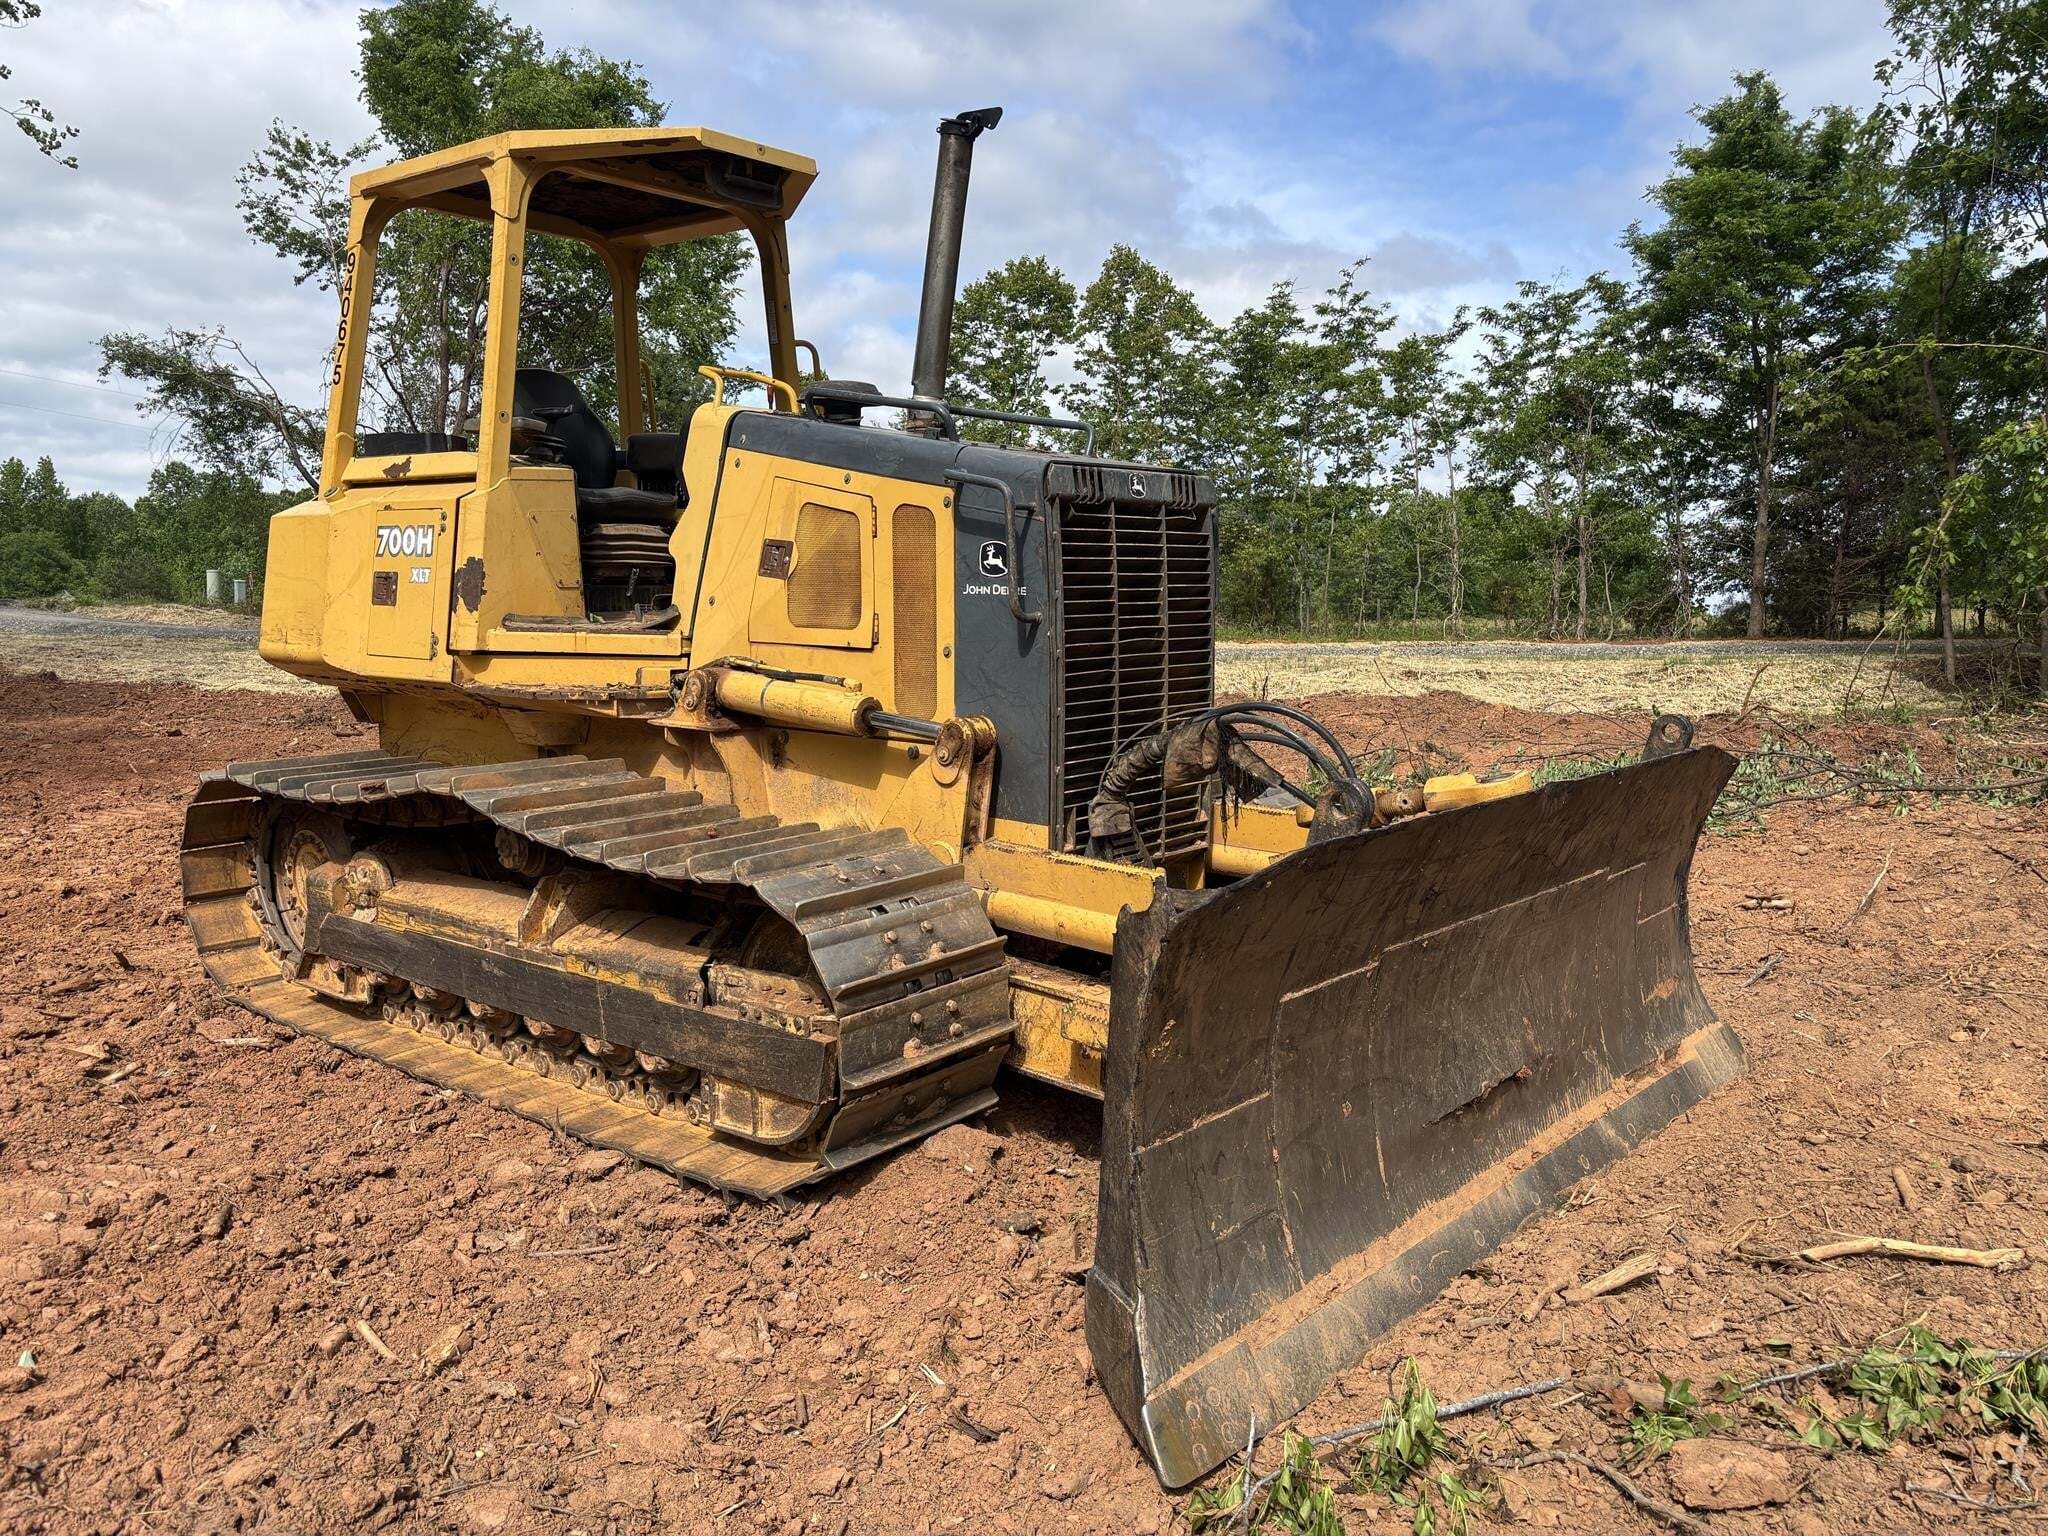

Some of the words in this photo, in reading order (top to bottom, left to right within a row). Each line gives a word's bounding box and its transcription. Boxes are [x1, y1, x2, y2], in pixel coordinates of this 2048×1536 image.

[332, 252, 356, 385] 940675
[376, 525, 434, 557] 700H
[408, 566, 431, 584] XLT
[963, 584, 990, 595] JOHN
[992, 584, 1027, 596] DEE
